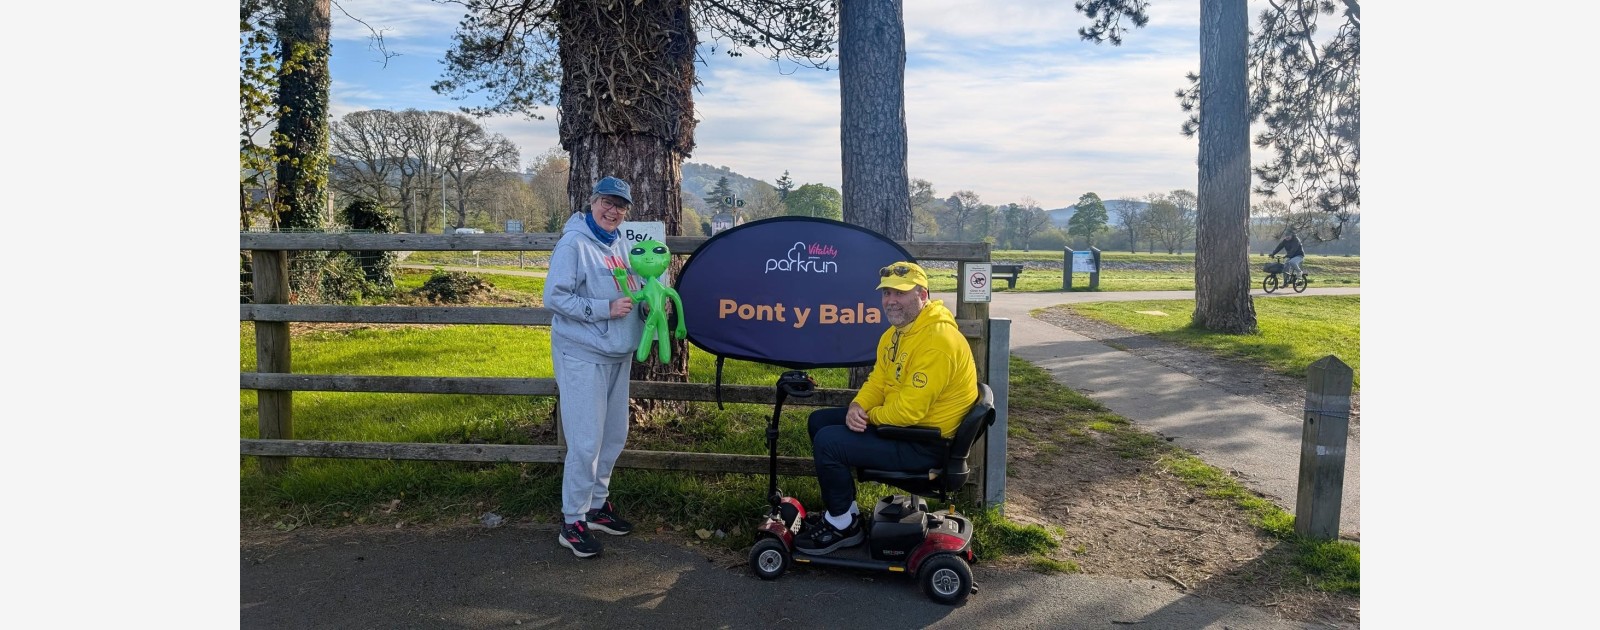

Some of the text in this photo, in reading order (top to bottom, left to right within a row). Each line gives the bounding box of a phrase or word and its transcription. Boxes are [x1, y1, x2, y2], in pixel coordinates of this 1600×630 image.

[765, 246, 838, 273] parkrun
[808, 242, 838, 258] Vitality
[719, 298, 881, 328] Pont y Bala
